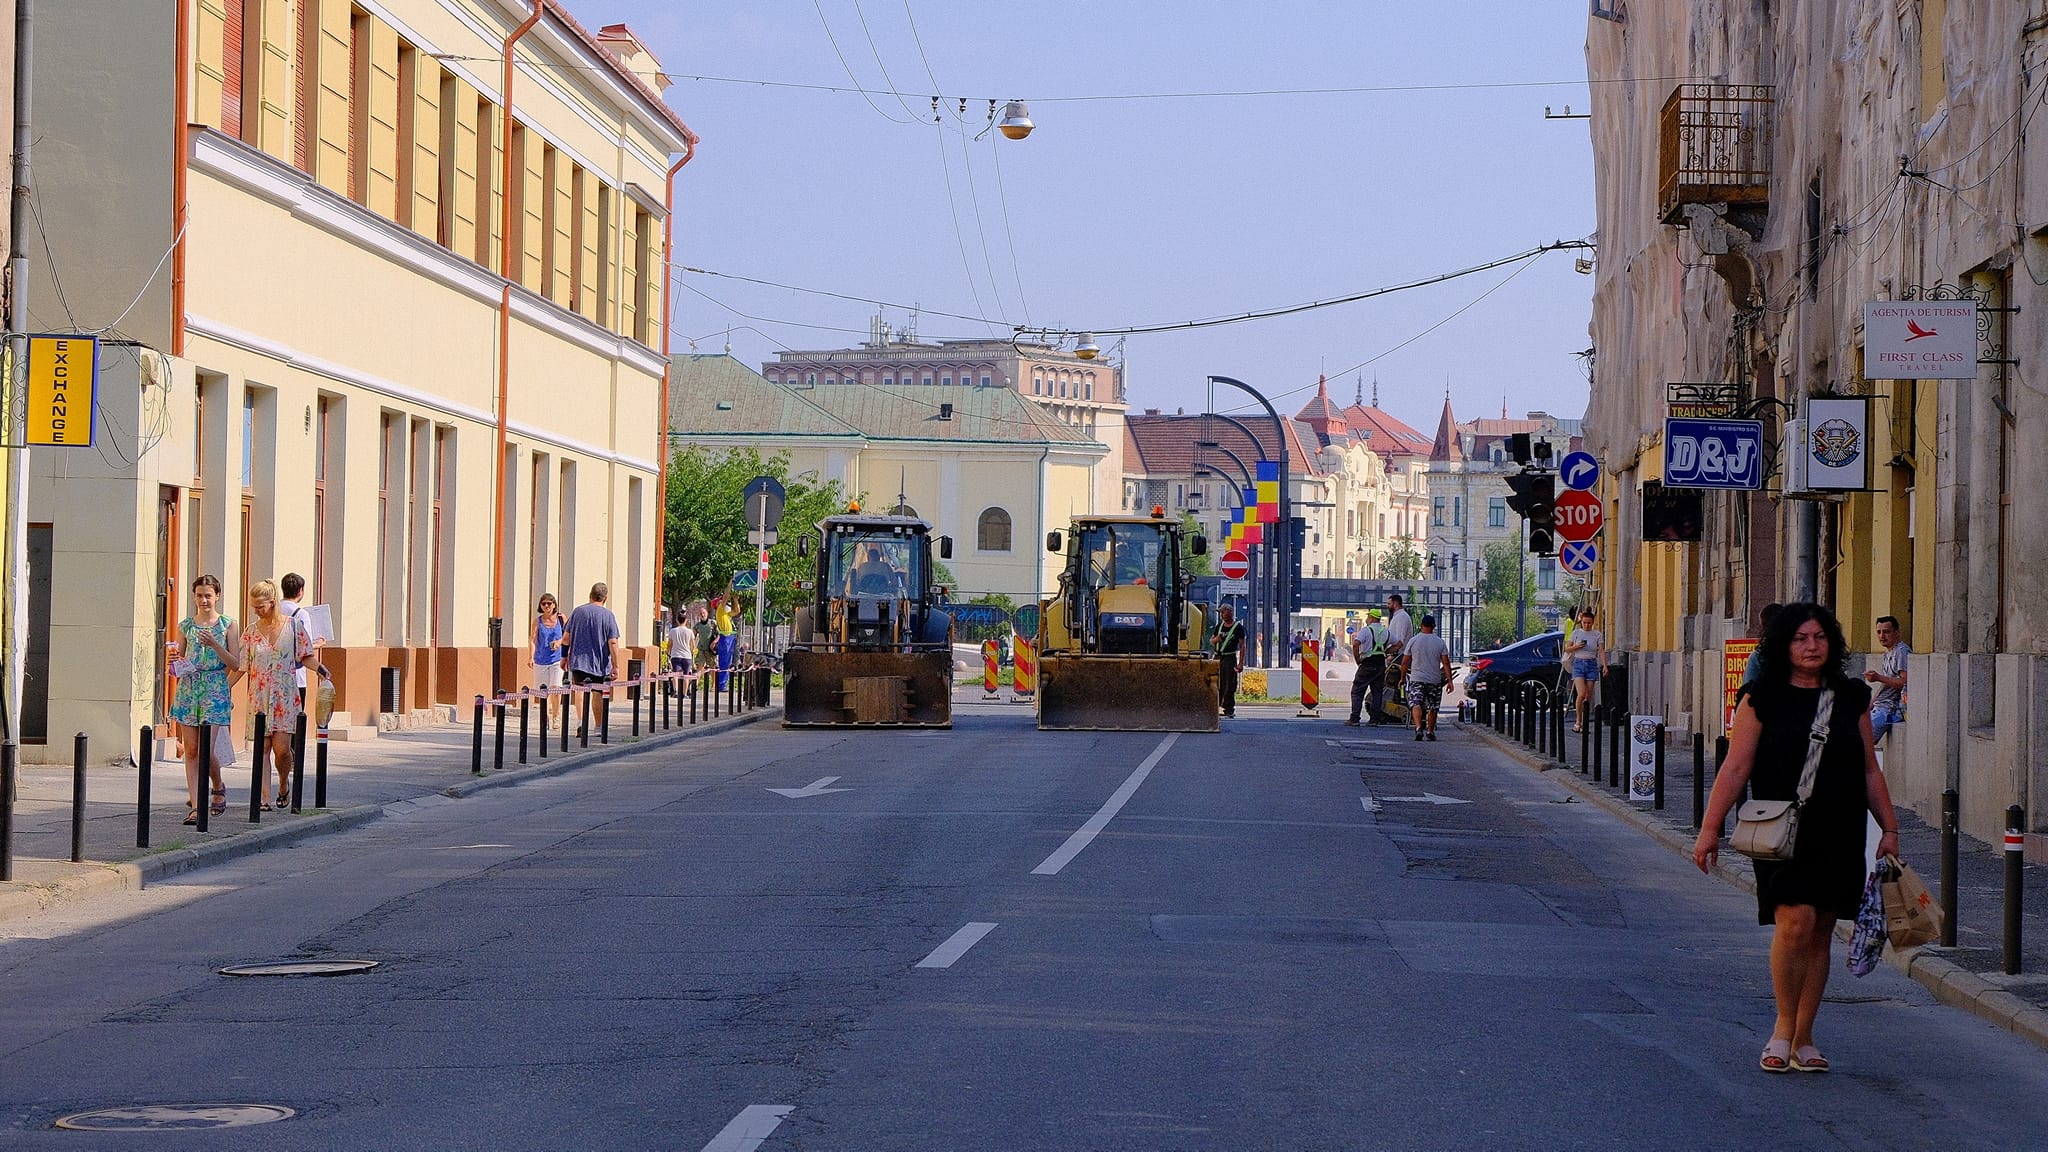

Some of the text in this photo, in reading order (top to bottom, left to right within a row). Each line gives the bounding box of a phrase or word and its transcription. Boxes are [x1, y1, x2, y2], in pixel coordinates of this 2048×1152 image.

[1917, 308, 1931, 317] DE
[1932, 308, 1971, 317] TURISM
[1880, 353, 1963, 362] FIRST CLASS
[52, 341, 68, 442] EXCHANGE
[1670, 436, 1757, 483] D&J
[1554, 505, 1600, 526] STOP
